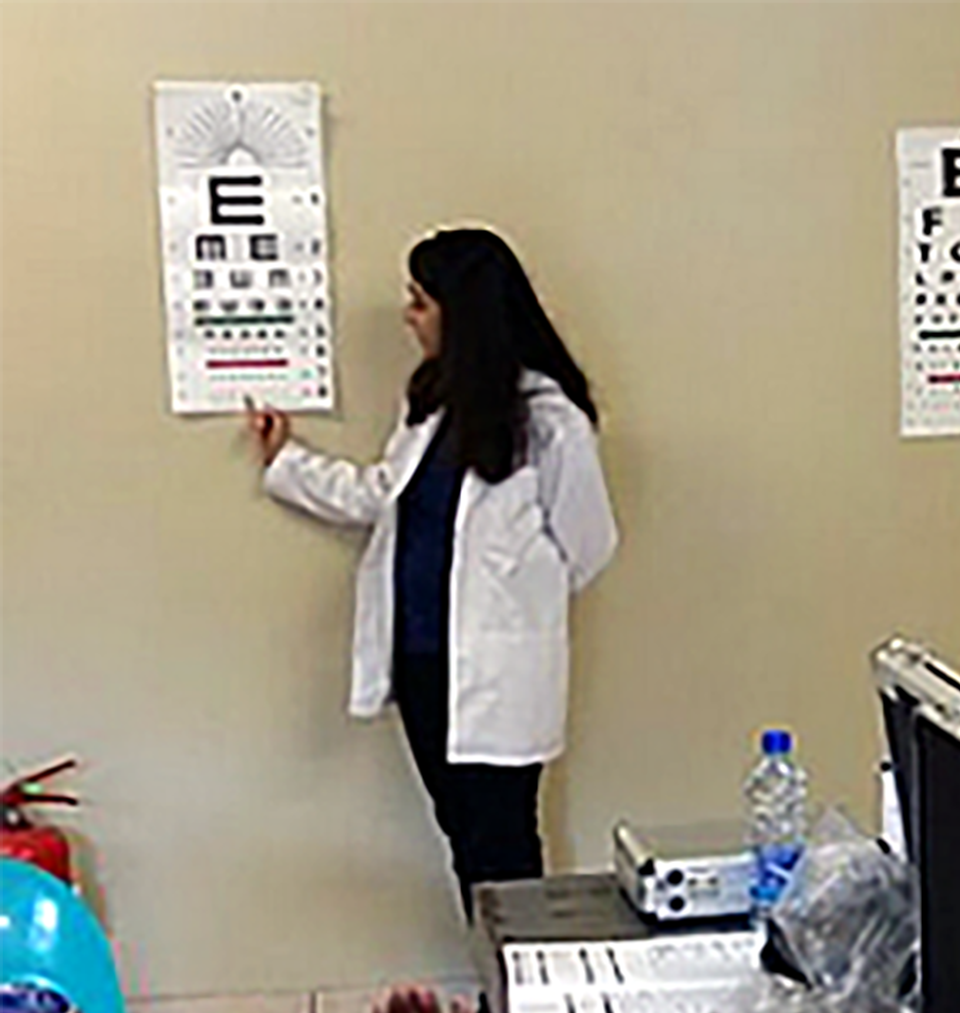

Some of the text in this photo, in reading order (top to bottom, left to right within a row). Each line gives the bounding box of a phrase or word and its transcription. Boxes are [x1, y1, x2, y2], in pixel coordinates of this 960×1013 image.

[209, 175, 265, 226] E
[922, 207, 943, 236] F
[249, 234, 278, 261] E
